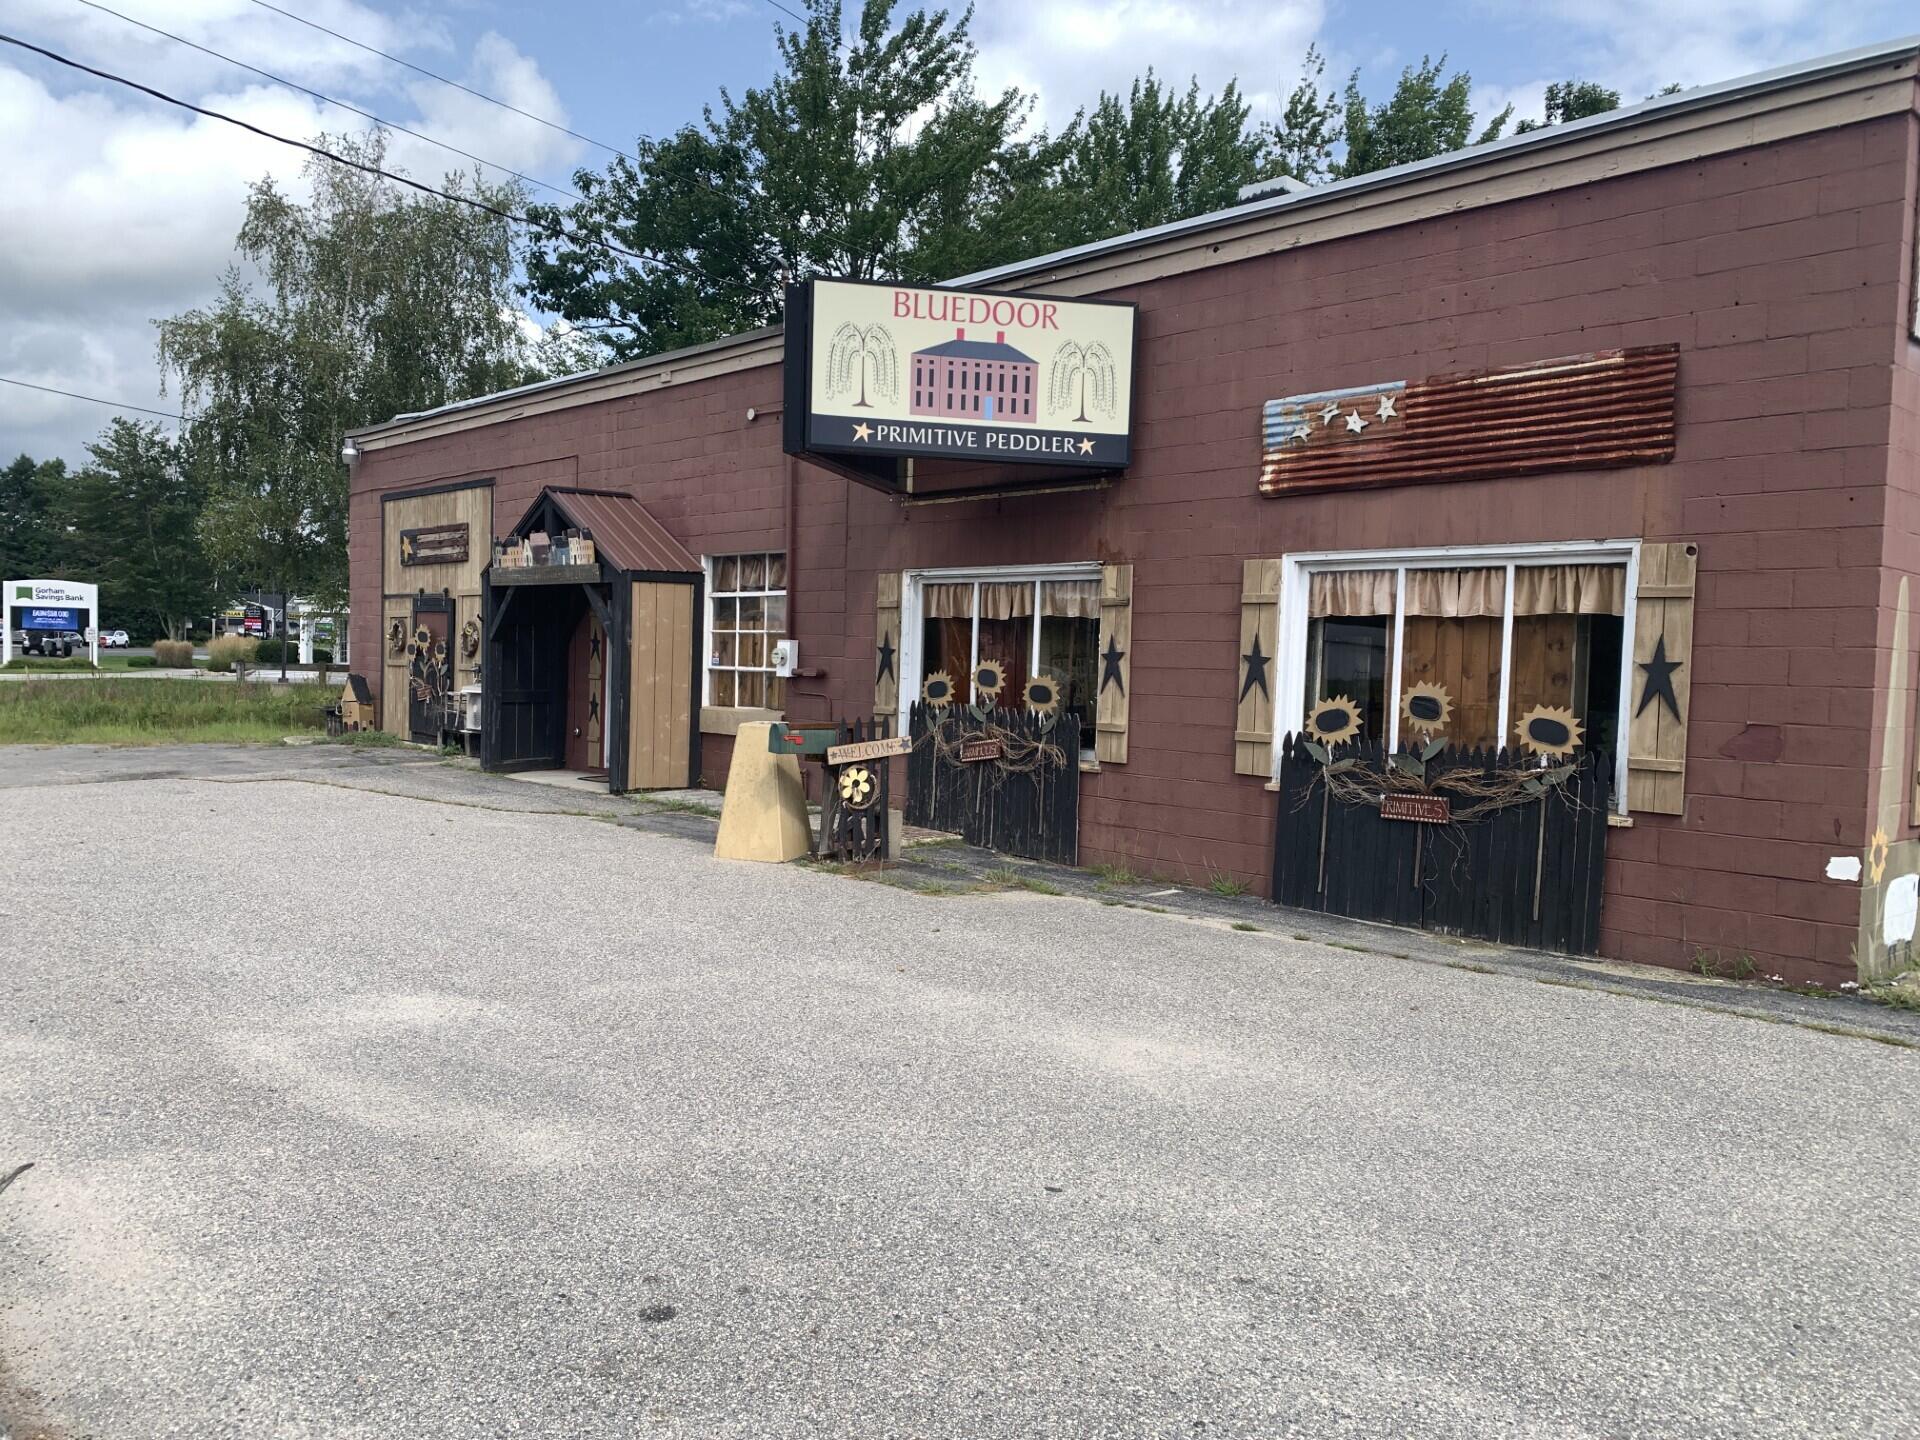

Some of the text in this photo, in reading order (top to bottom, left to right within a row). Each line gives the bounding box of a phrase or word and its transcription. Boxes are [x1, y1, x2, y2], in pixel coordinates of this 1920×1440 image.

[893, 291, 1059, 330] BLUEDOOR
[876, 425, 1076, 453] PRIMITIVE PEDDLER
[35, 594, 64, 602] Savings
[839, 741, 898, 759] WELCOME
[1381, 800, 1443, 818] PRIMITIVES
